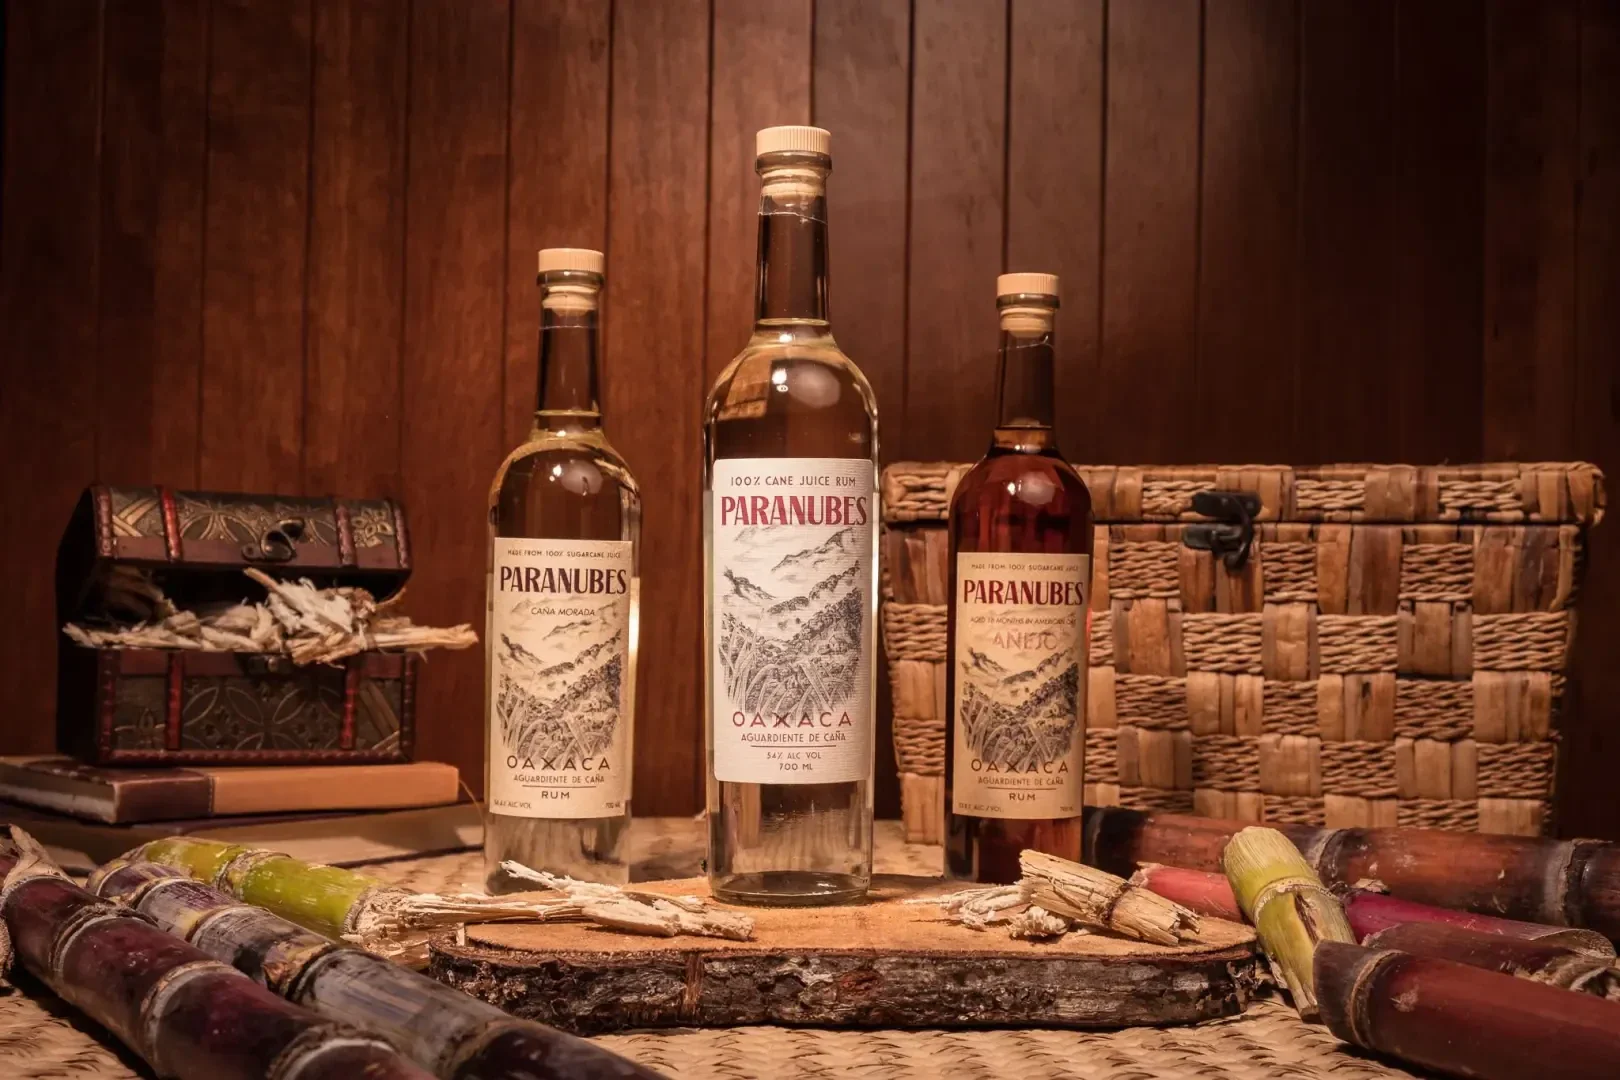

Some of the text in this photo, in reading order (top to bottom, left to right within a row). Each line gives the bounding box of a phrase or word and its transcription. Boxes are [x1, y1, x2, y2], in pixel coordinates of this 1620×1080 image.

[731, 475, 856, 487] 100% CANE JUICE RUM
[721, 495, 867, 526] PARANUBES
[567, 550, 604, 559] SUGARCANE
[607, 551, 621, 559] JUICE
[500, 566, 627, 594] PARANUBES
[964, 579, 1084, 606] PARANUBES
[531, 606, 595, 616] CAÑA MORADA
[732, 711, 852, 728] OAXACA
[741, 731, 846, 743] AGUARDIENTE DE CAÑA
[767, 751, 821, 760] 54% ALC VOL
[506, 755, 610, 771] OAXACA
[779, 763, 813, 771] 700 ML
[971, 758, 1069, 774] OAXACA
[513, 773, 605, 783] AGUARDIENTE DE CAÑA
[978, 776, 1030, 786] AGUARDIENTE
[1046, 776, 1064, 785] CAÑA
[541, 790, 570, 800] RUM
[1009, 792, 1036, 801] RUM
